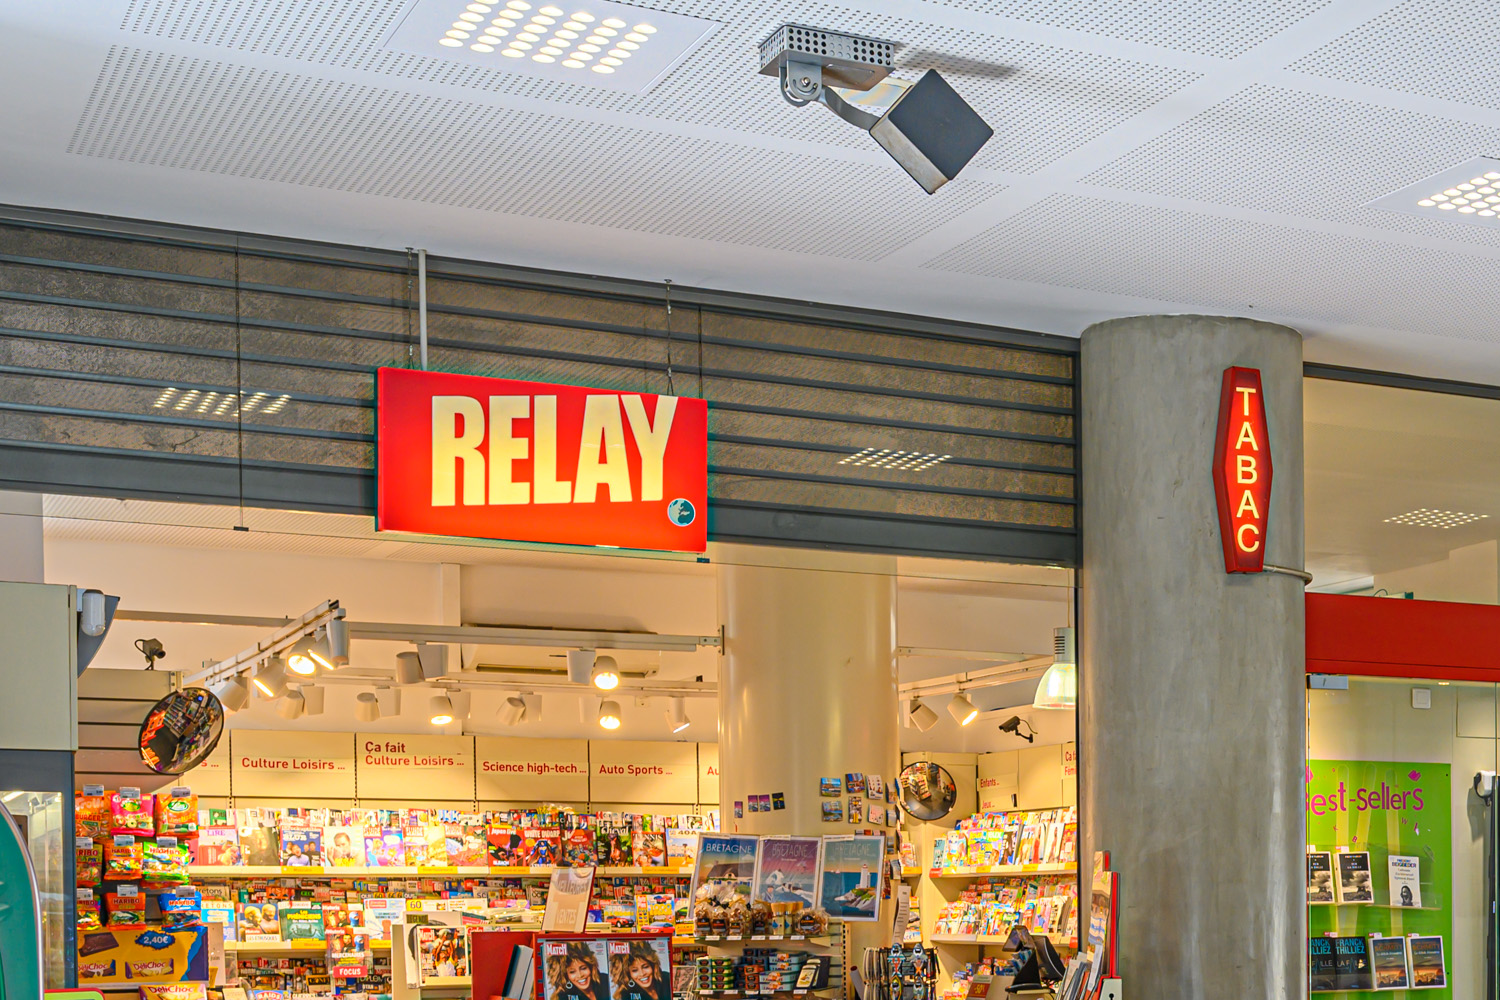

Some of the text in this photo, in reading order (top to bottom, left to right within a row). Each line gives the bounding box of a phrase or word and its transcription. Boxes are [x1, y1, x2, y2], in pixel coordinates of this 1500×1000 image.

[431, 394, 679, 507] RELAY
[1235, 386, 1260, 553] TABAC
[365, 741, 406, 755] Ça fait
[242, 758, 335, 770] Culture Loisirs
[365, 755, 455, 767] Culture Loisirs
[483, 761, 577, 776] Science high-tech
[599, 765, 664, 777] Auto Sports
[980, 778, 996, 788] Enfants
[982, 800, 992, 809] Jeux
[706, 843, 752, 853] BRETAGNE
[143, 935, 169, 944] 2,40€
[1335, 938, 1365, 946] FRANCK
[547, 944, 567, 955] MATCH
[609, 942, 630, 954] MATCH
[1336, 946, 1365, 954] THILLIEZ
[133, 961, 165, 970] DéliChoc
[339, 967, 361, 976] FOCUS
[148, 985, 194, 994] DéliChoc
[257, 992, 282, 1000] RAIDS
